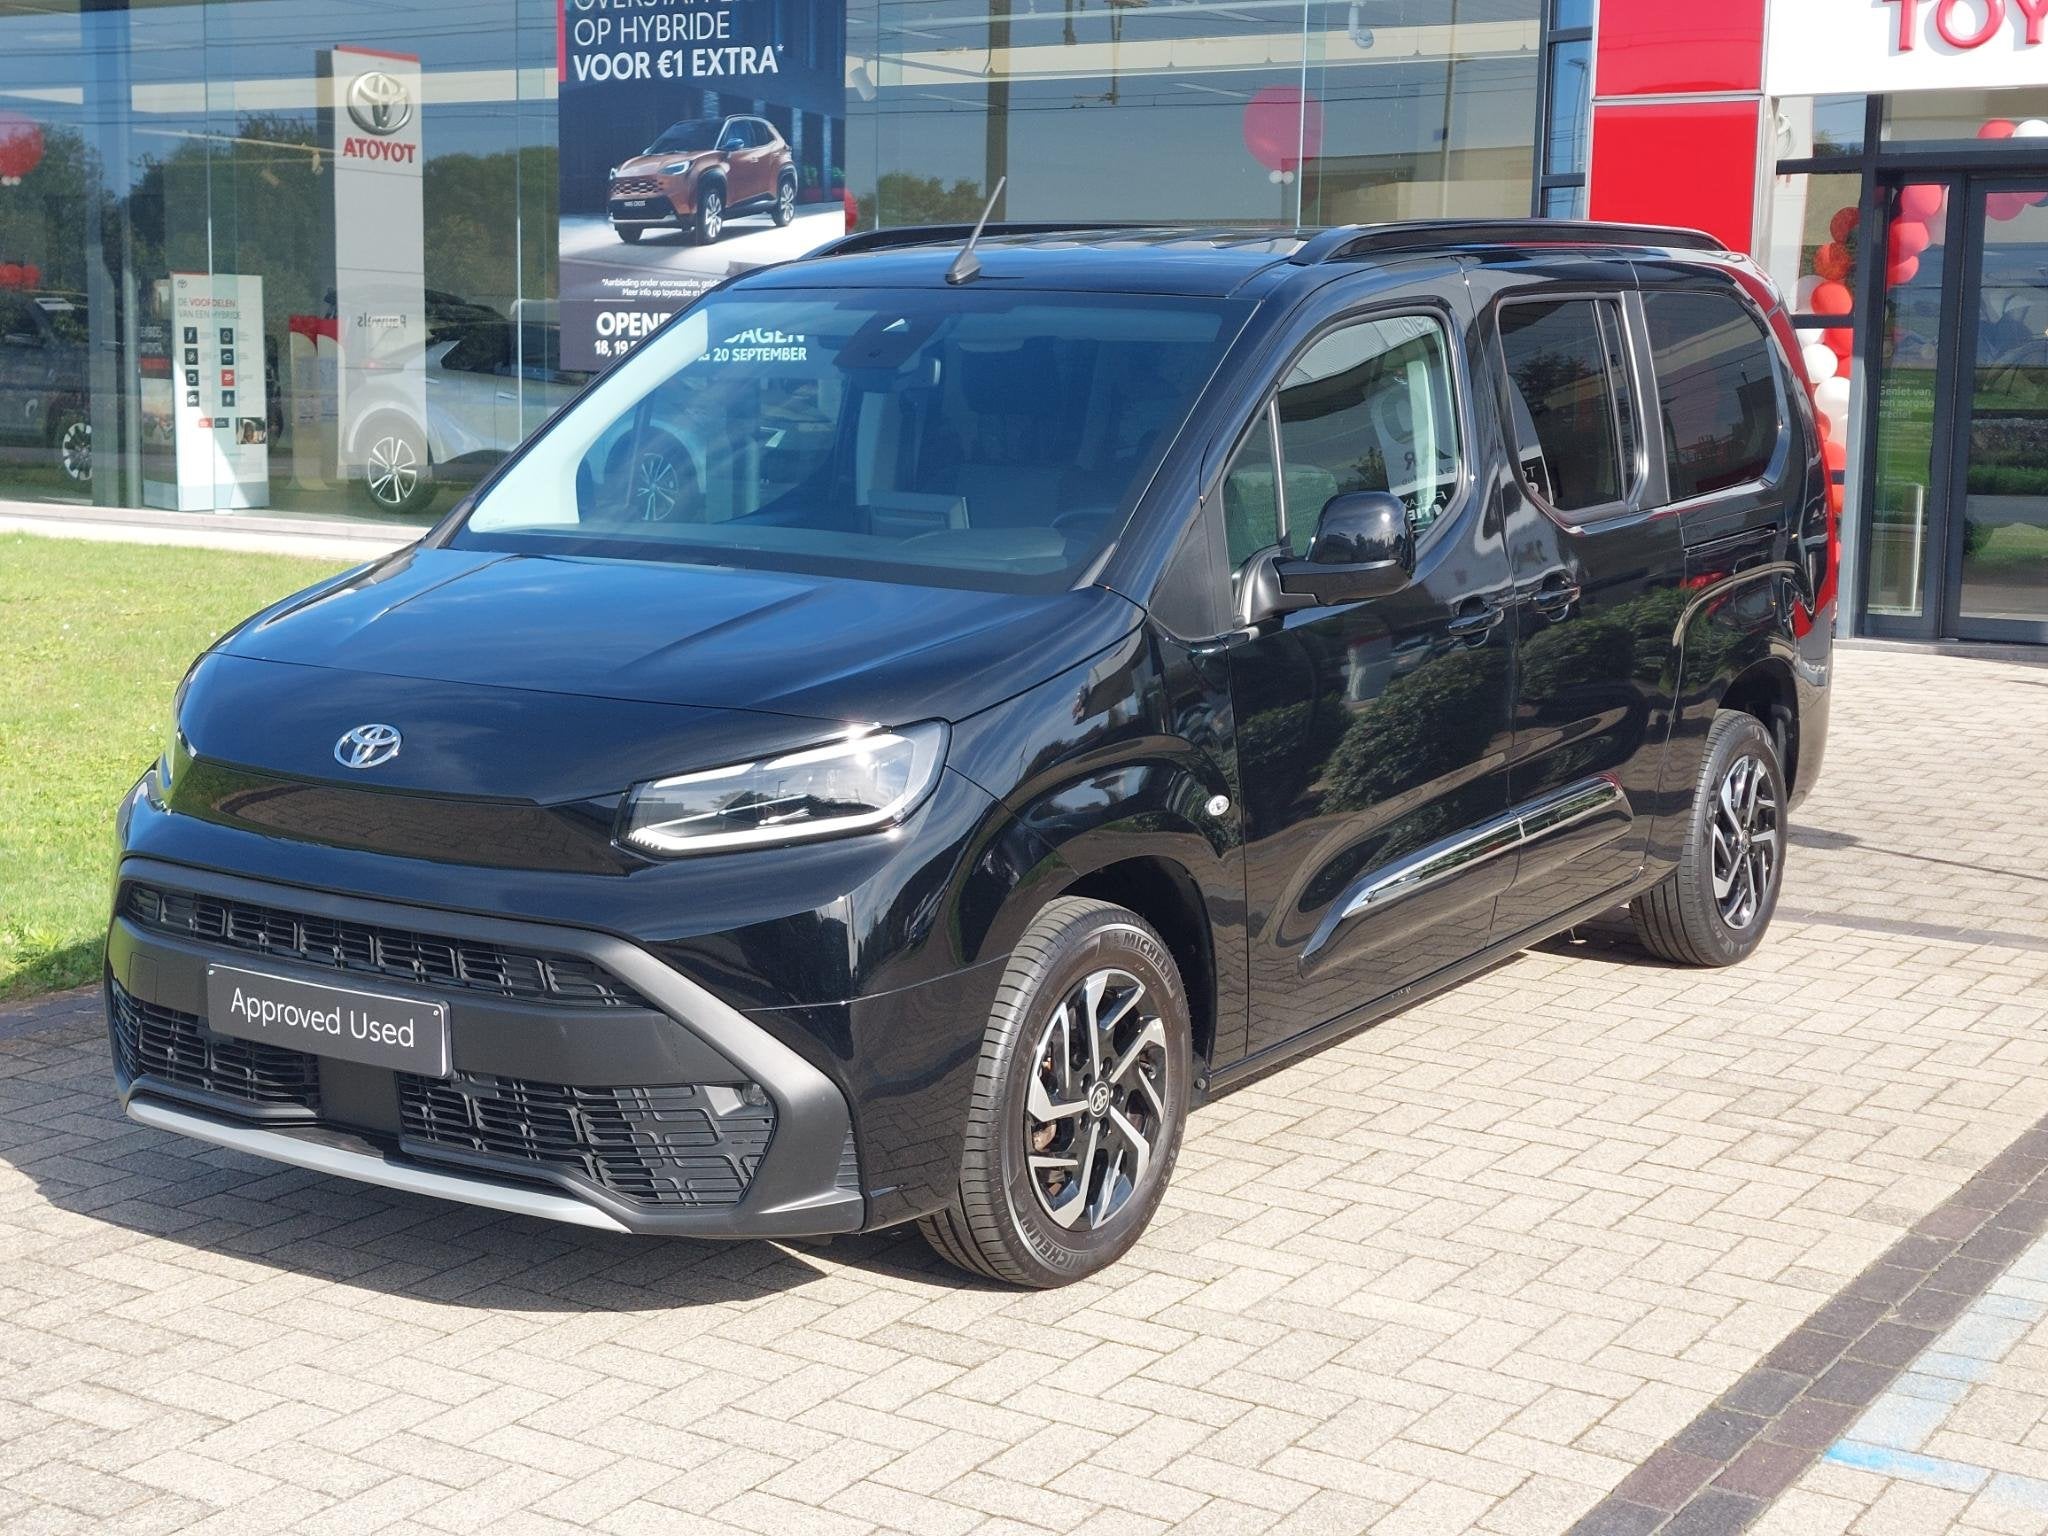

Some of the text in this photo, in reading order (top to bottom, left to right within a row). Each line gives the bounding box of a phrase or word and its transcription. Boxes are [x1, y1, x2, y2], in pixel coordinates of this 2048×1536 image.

[574, 11, 730, 46] OP HYBRIDE
[1882, 0, 2048, 51] TOY
[573, 51, 651, 81] VOOR
[657, 50, 683, 78] €1
[594, 339, 612, 357] 18,
[713, 347, 730, 361] 20
[731, 346, 807, 361] SEPTEMBER
[230, 987, 415, 1048] Approved Used
